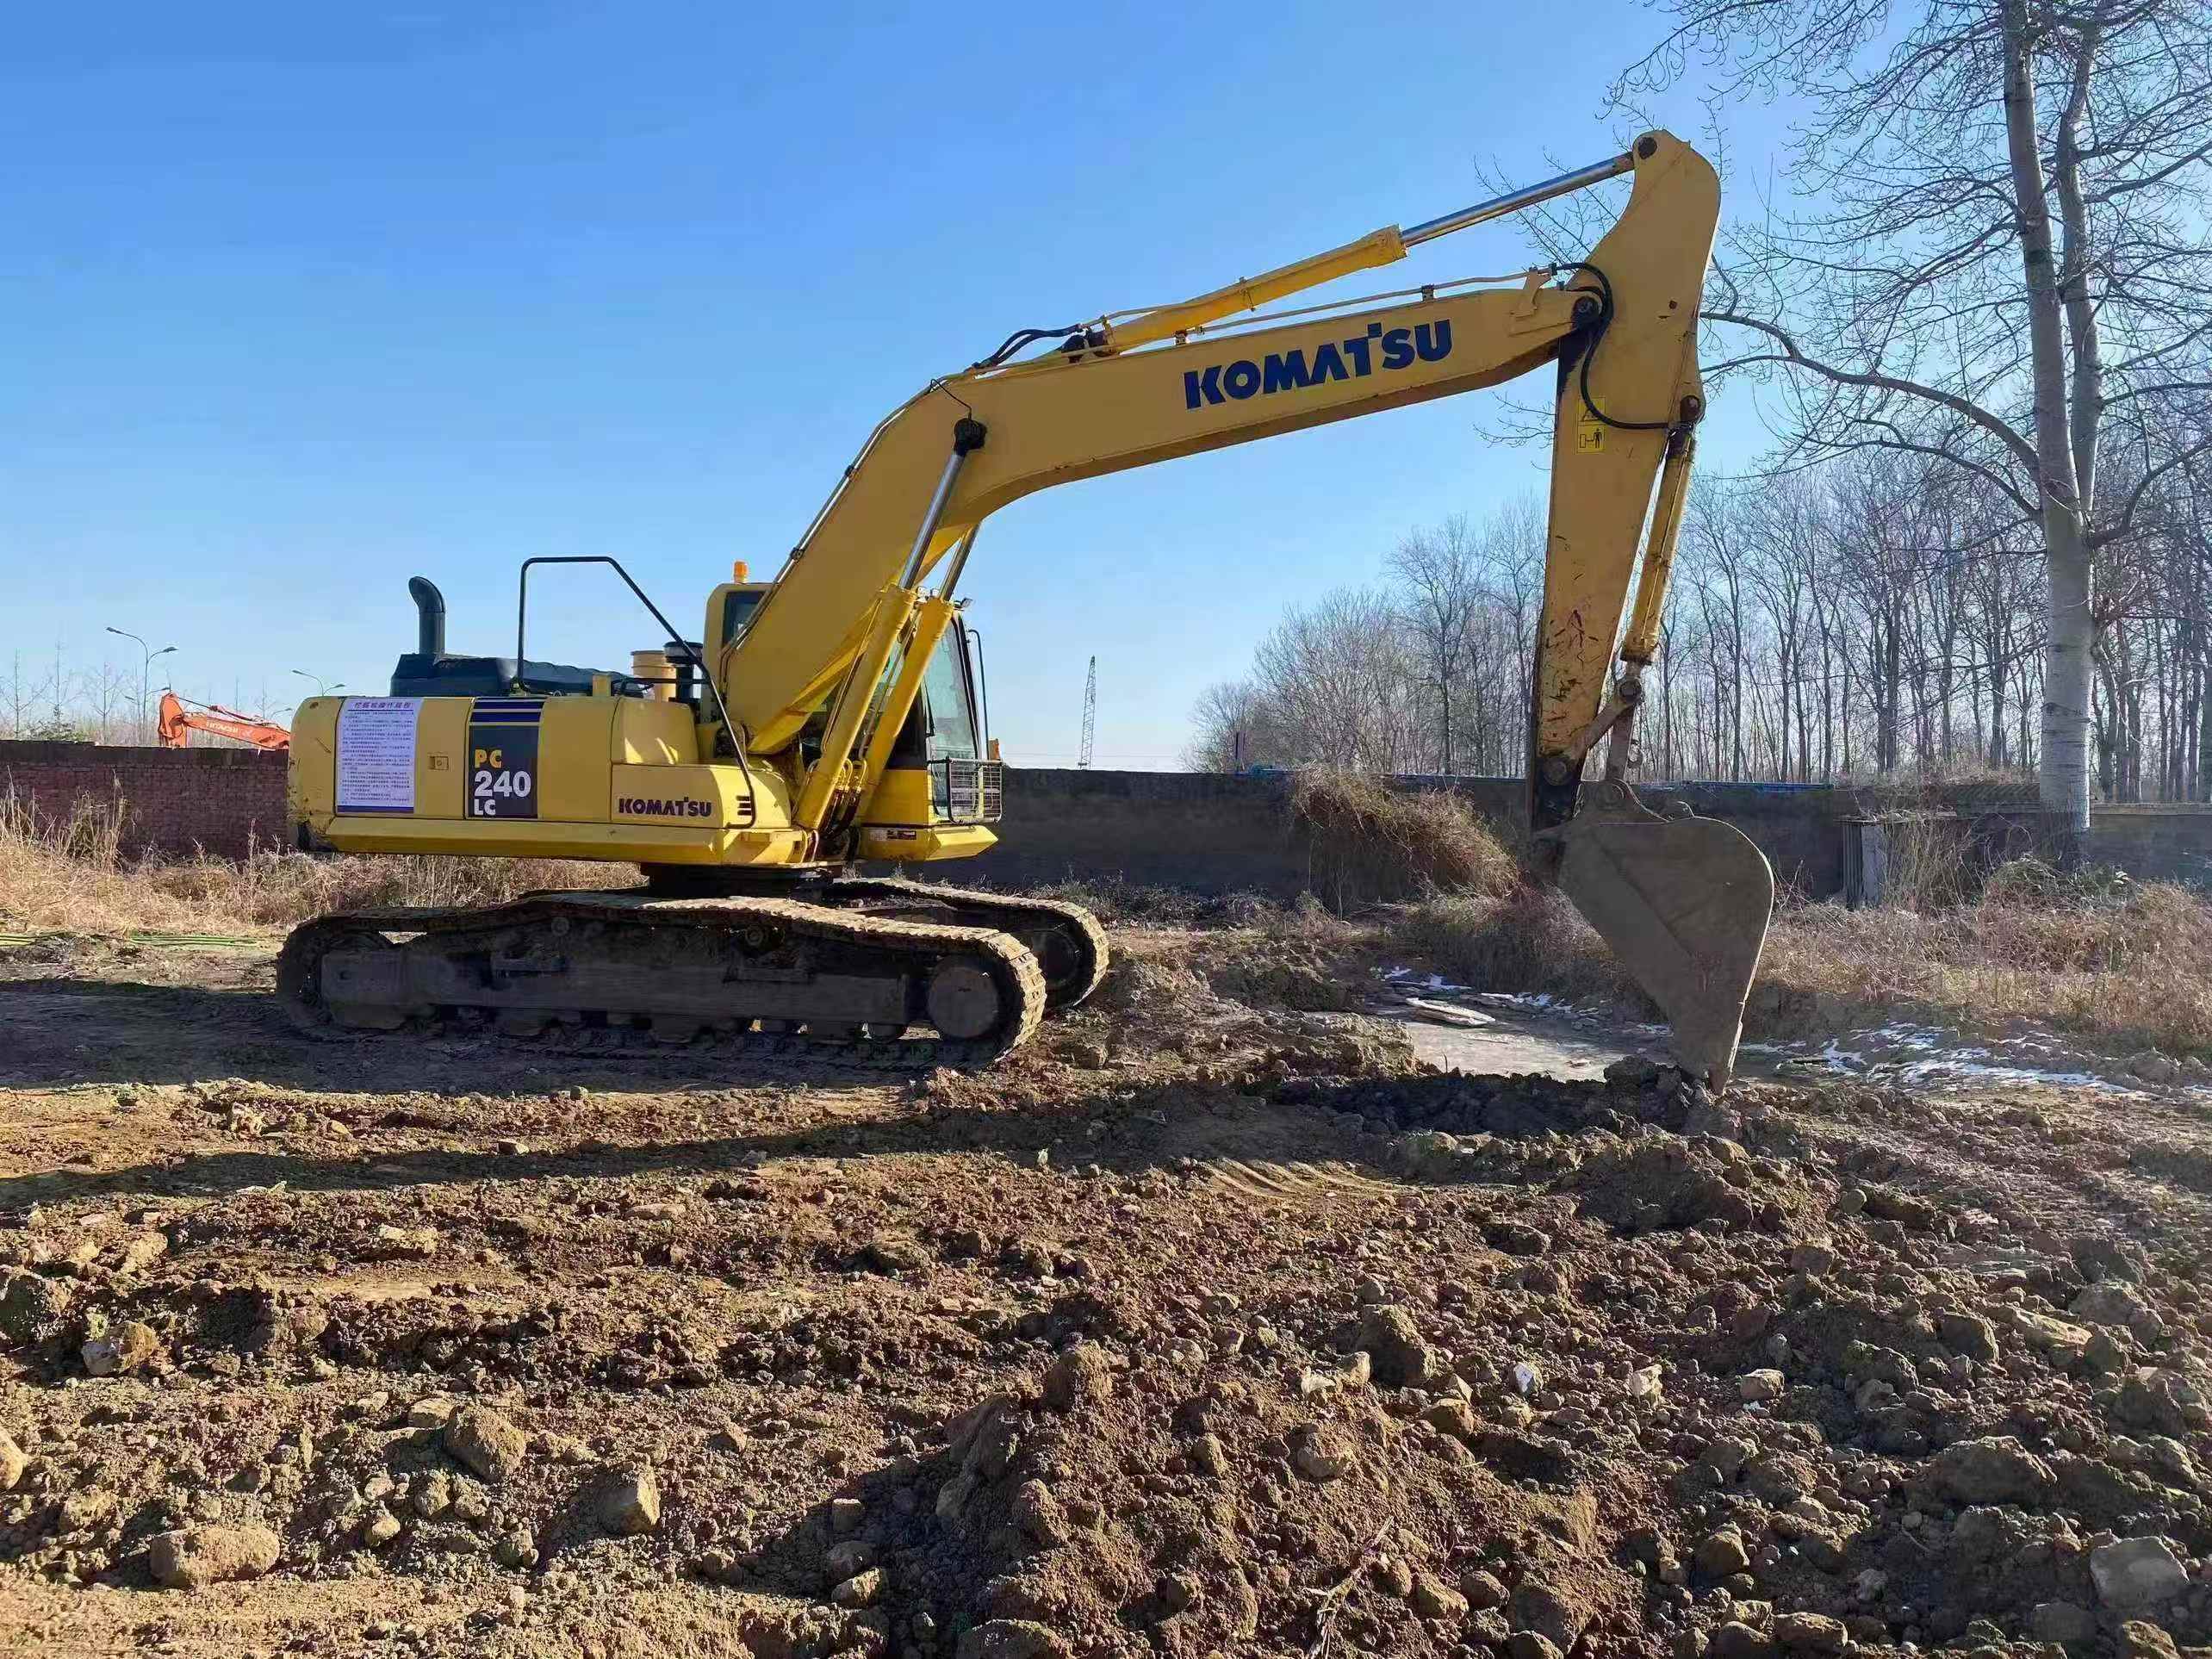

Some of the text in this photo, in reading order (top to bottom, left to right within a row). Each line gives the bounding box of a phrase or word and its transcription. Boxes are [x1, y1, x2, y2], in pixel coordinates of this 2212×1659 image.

[1184, 319, 1453, 409] KOMATSU
[475, 749, 501, 768] PC
[475, 770, 531, 798] 240
[474, 798, 495, 816] LC
[618, 797, 712, 817] KOMATSU
